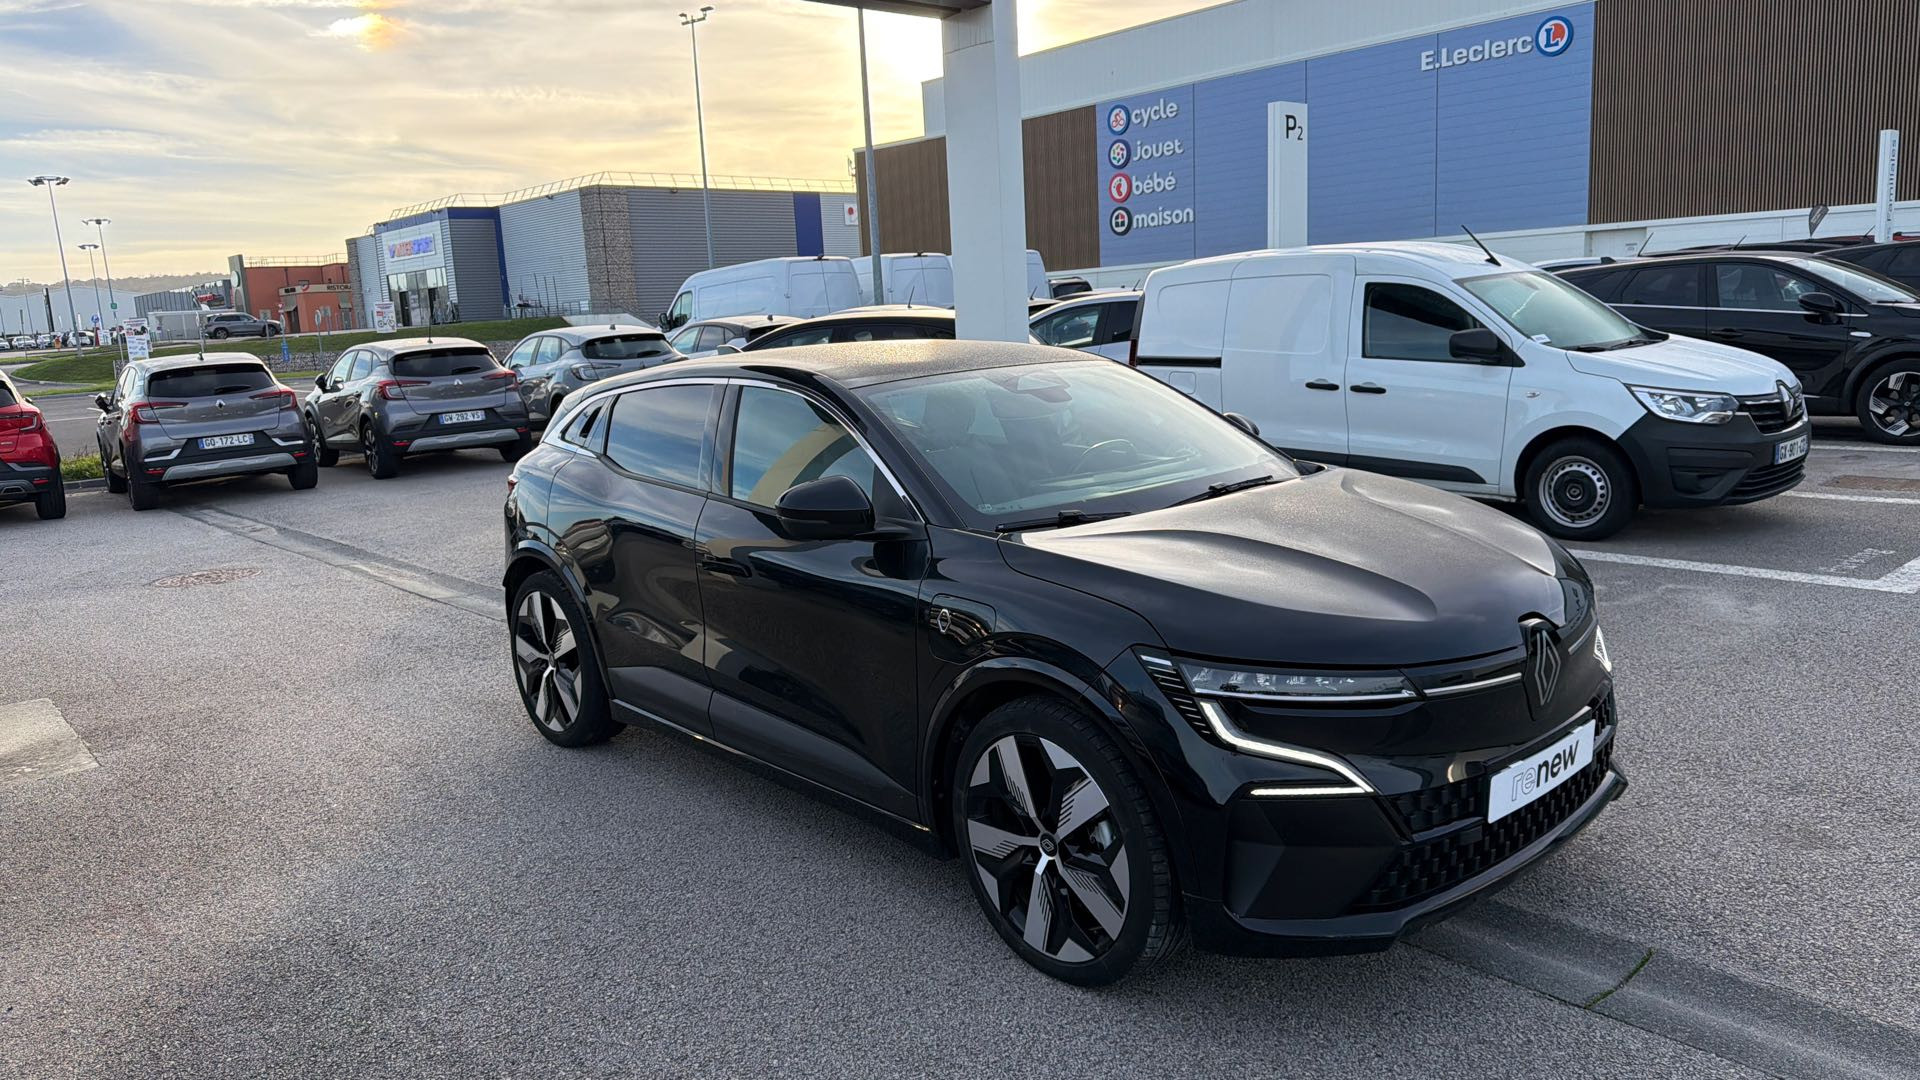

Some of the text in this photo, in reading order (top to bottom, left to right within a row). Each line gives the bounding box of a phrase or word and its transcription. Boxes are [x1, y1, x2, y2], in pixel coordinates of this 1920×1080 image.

[1421, 35, 1533, 71] E.Leclerc
[1131, 98, 1178, 127] cycle
[1133, 138, 1184, 161] jouet
[1132, 171, 1176, 195] bébé
[1133, 206, 1194, 228] maison
[1511, 739, 1580, 802] renew
